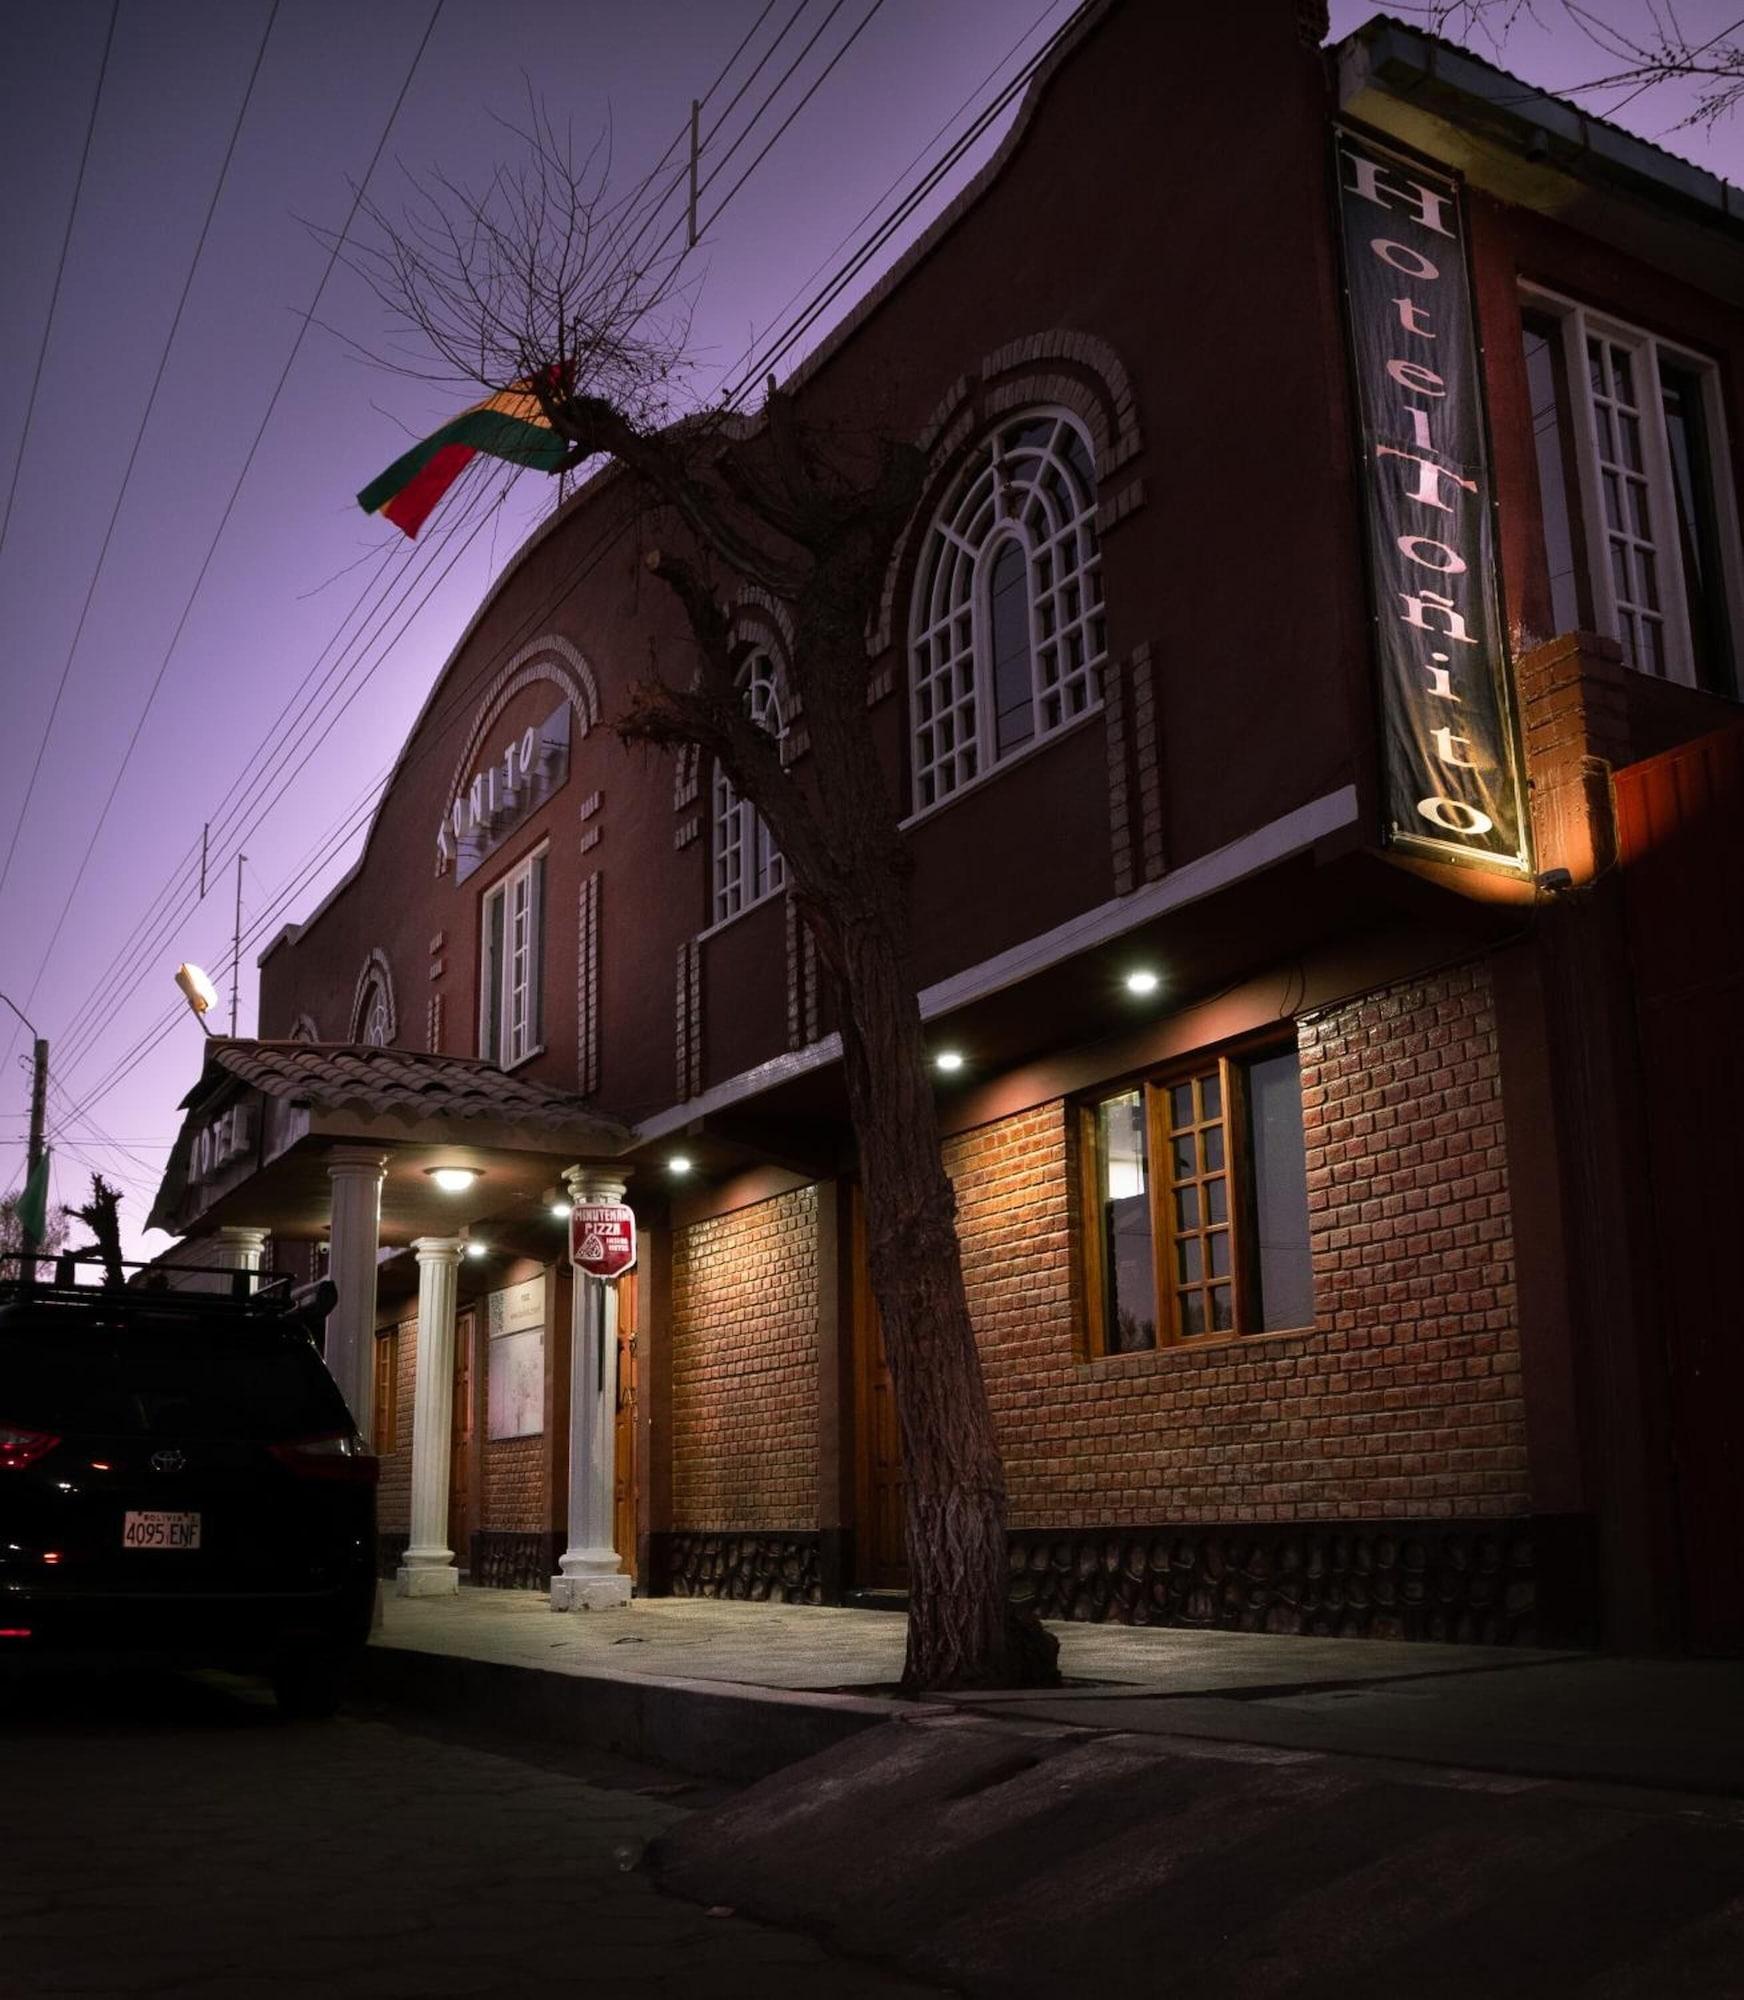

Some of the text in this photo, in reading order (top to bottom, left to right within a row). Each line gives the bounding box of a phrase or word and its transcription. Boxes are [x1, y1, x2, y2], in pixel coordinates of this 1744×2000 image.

[1341, 148, 1493, 836] Hotel Toñito
[584, 1222, 621, 1236] PIZZA
[126, 1522, 165, 1545] 4095
